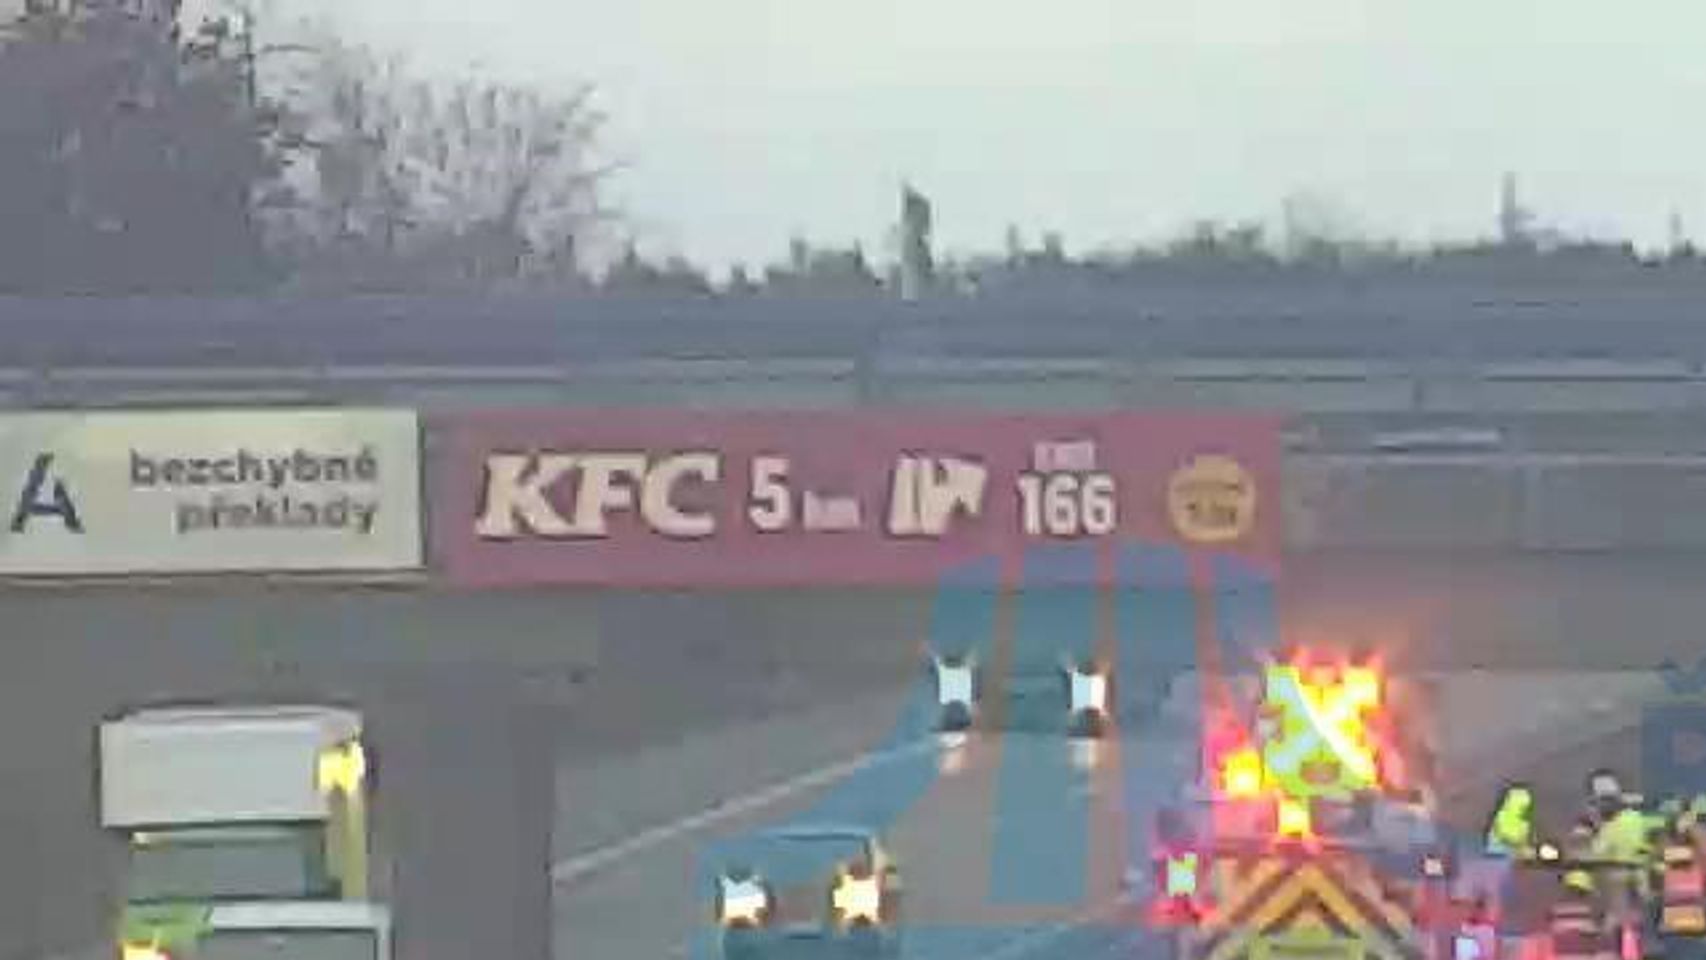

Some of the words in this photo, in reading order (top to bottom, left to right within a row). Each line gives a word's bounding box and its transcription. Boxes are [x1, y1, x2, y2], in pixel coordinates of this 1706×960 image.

[130, 448, 378, 488] bezchybné
[177, 497, 378, 534] překlady
[474, 453, 720, 538] KFC
[748, 457, 791, 532] 5
[1018, 473, 1116, 535] 166
